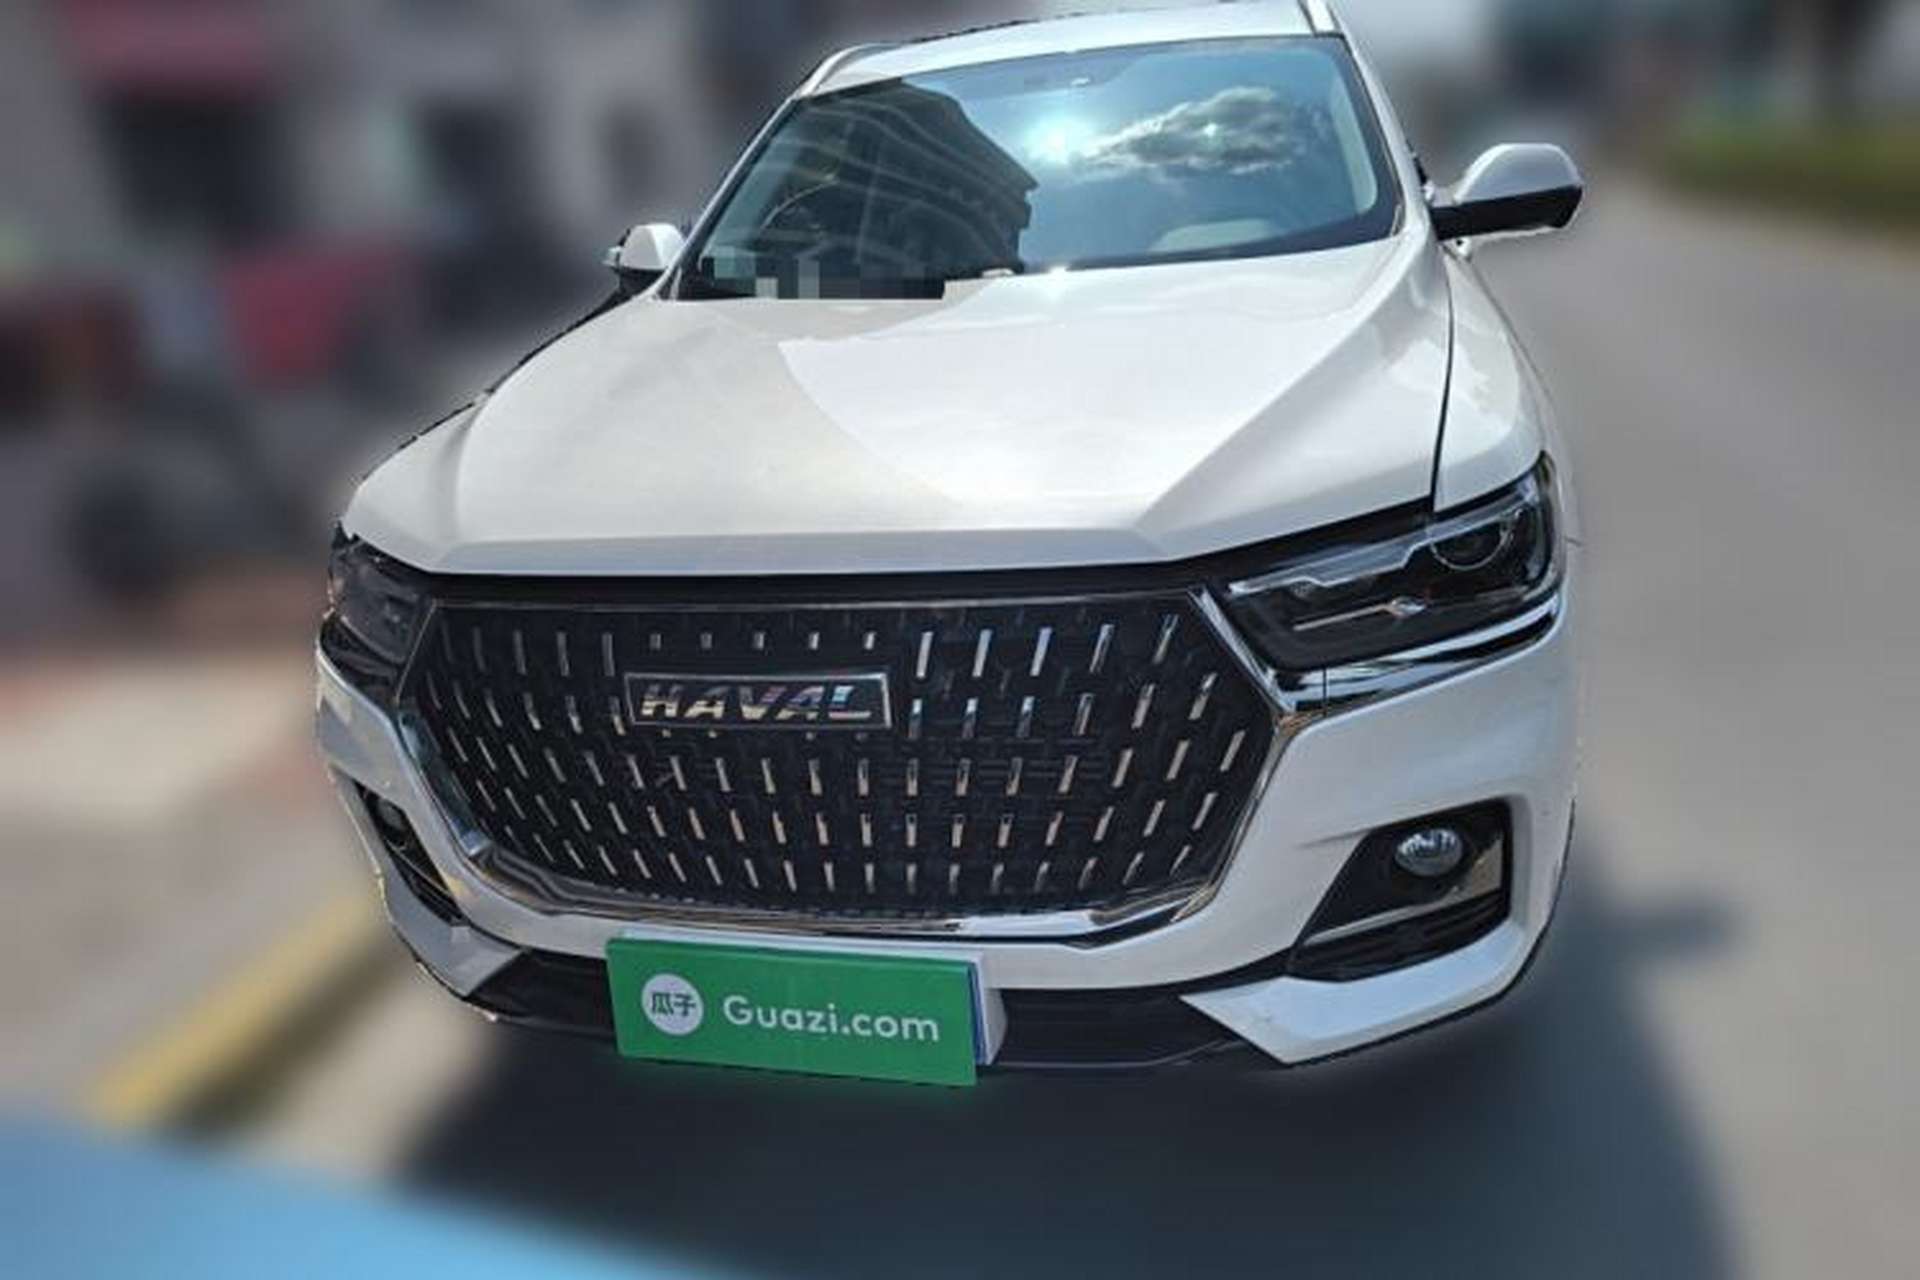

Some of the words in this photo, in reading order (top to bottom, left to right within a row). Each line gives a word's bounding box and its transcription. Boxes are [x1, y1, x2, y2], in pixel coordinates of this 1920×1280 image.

[640, 685, 872, 720] HAVAL
[650, 991, 697, 1017] 瓜子
[722, 995, 940, 1042] Guazi.com
